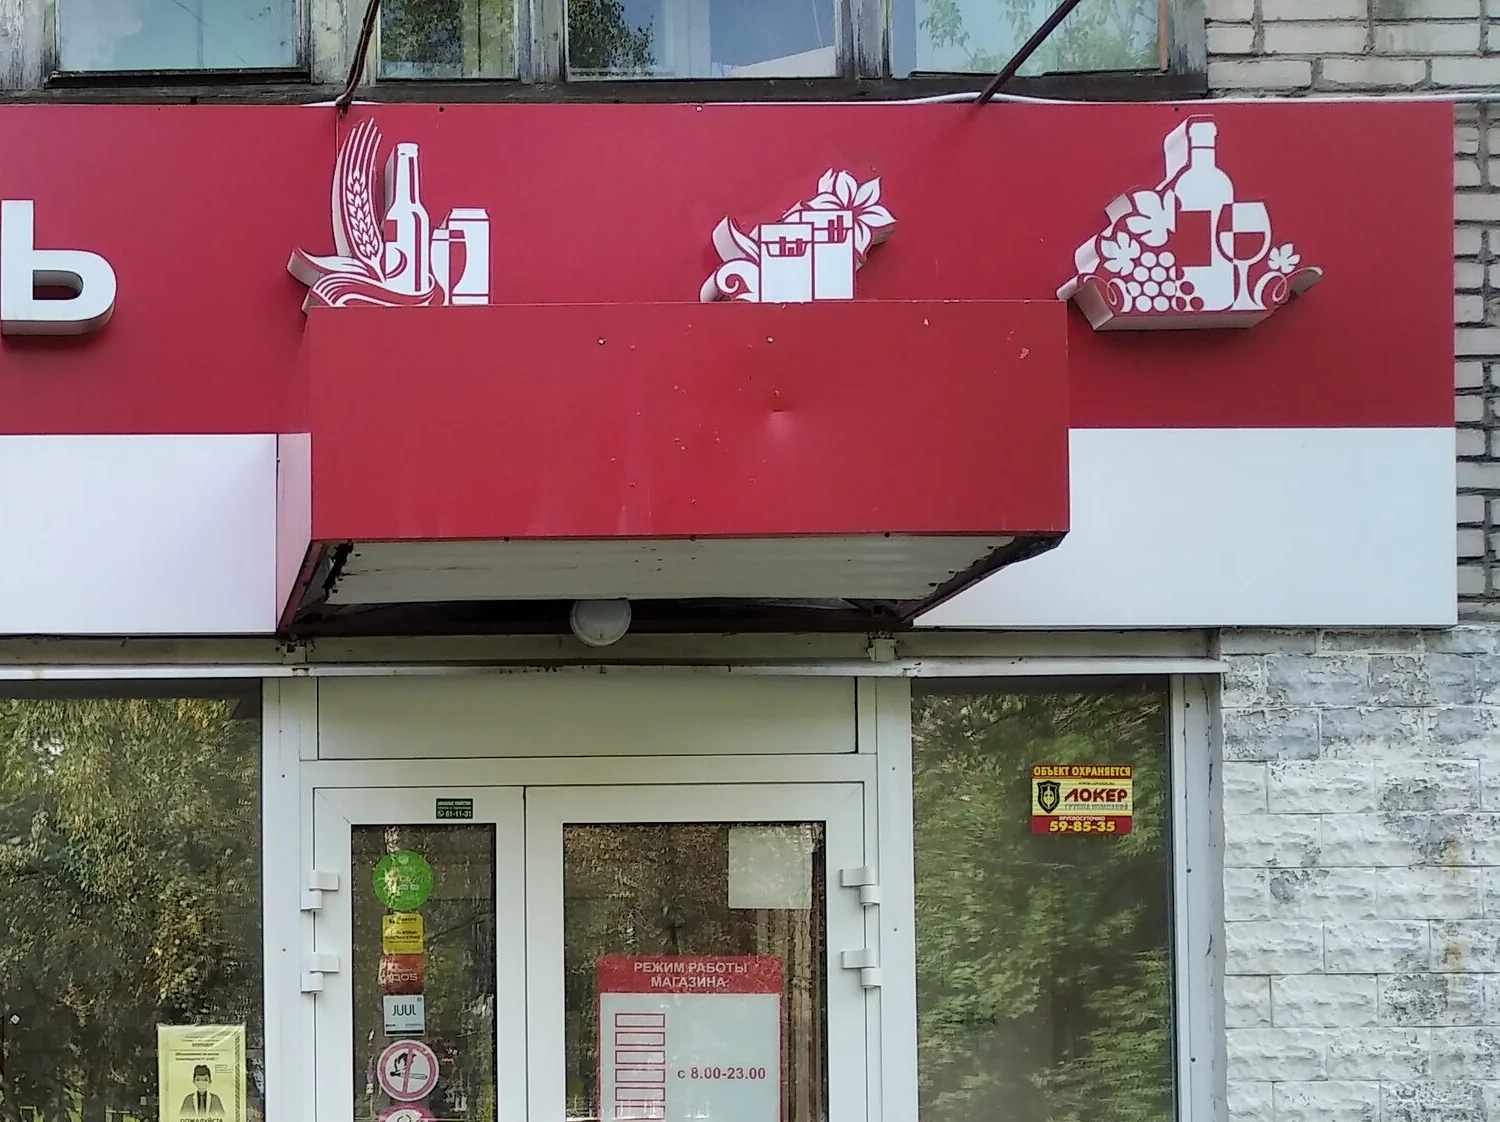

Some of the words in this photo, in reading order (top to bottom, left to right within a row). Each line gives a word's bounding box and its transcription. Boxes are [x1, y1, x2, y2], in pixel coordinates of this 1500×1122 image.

[1033, 766, 1069, 776] ОБЪЕКТ
[1071, 766, 1131, 777] ОХРАНЯЕТСЯ
[1064, 788, 1128, 802] ЛОКЕР
[1049, 821, 1116, 832] 59-85-35
[634, 962, 685, 974] РЕЖИМ
[688, 962, 748, 974] РАБОТЫ
[393, 1003, 417, 1016] JUUL
[677, 1069, 686, 1080] с
[690, 1066, 766, 1081] 8.00-23.00
